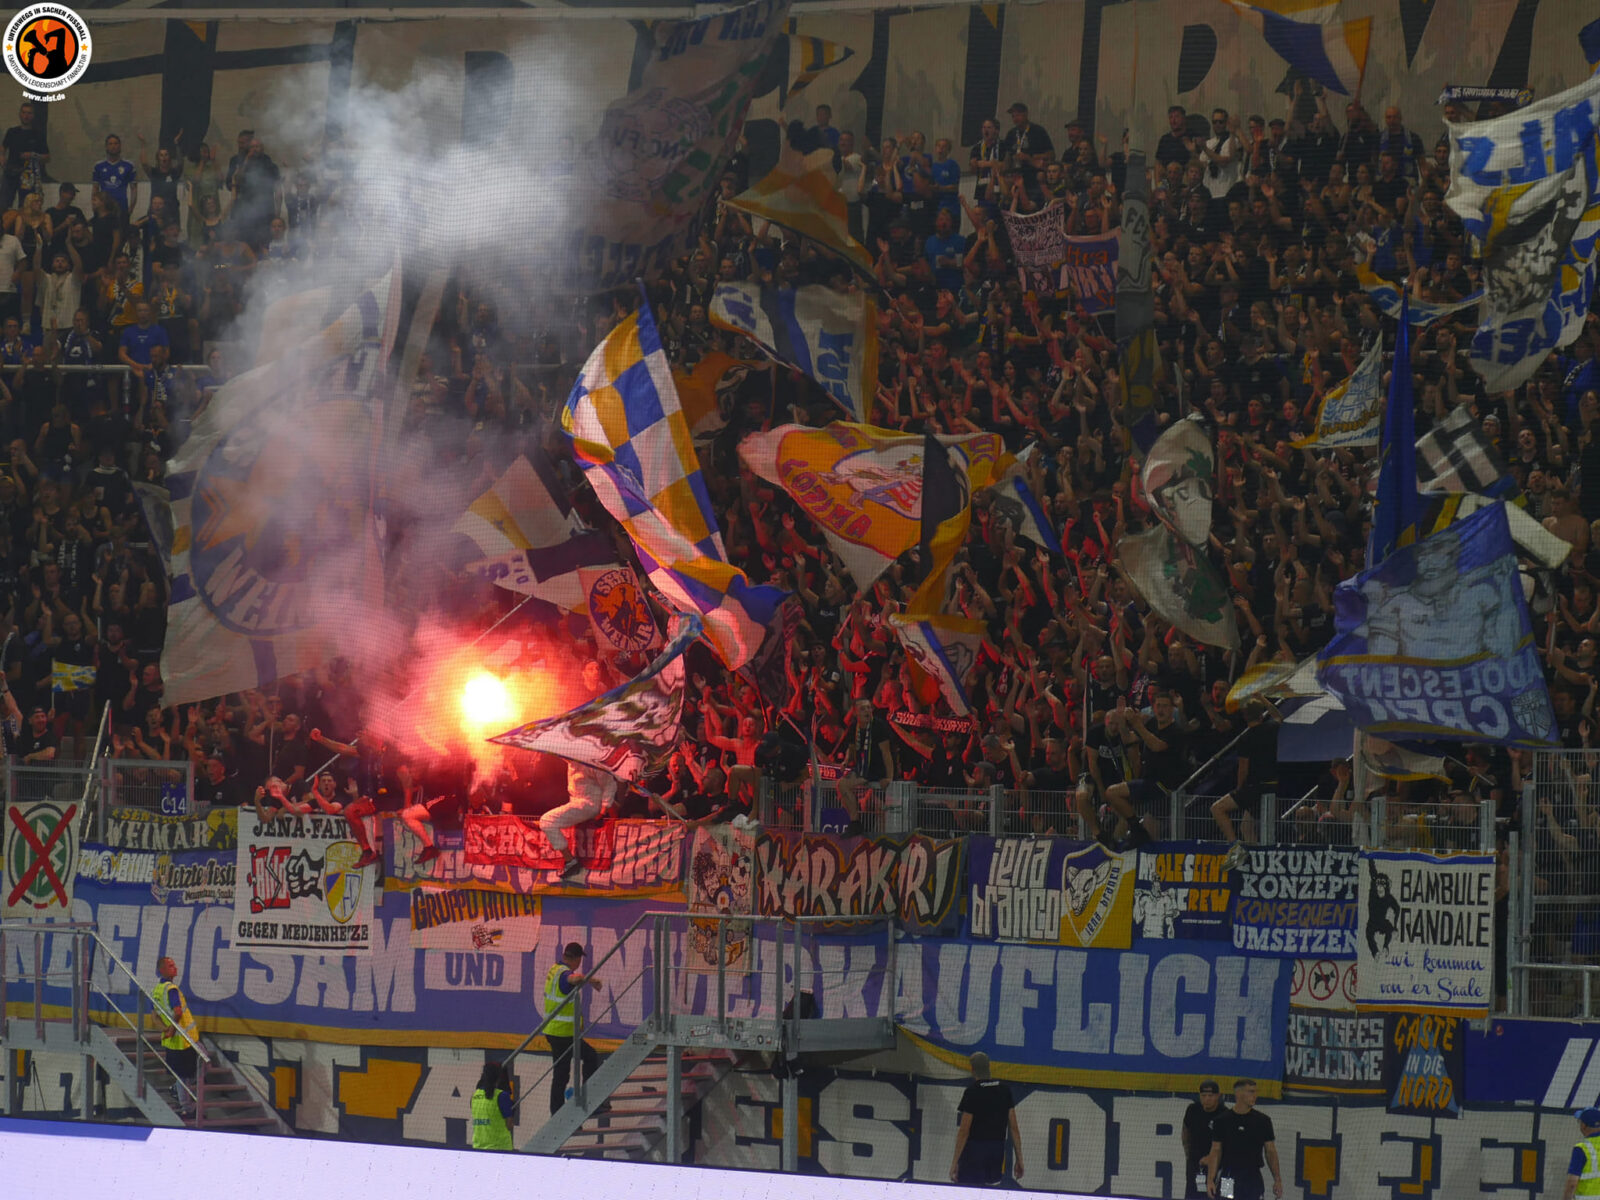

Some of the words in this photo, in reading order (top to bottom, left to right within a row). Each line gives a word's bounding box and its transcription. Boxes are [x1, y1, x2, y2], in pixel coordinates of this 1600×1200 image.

[161, 797, 187, 814] C14
[106, 817, 209, 850] WEIMAR
[757, 839, 954, 917] HARAKIRI
[1239, 873, 1359, 900] KONZEPT
[1400, 869, 1491, 906] BAMBULE
[238, 920, 279, 939] GEGEN
[1233, 899, 1358, 929] KONSEQUENT
[1400, 908, 1490, 947] RANDALE
[445, 952, 505, 987] UND
[1437, 977, 1485, 1001] Saale
[1287, 1013, 1385, 1048] REFUGEES
[1285, 1046, 1384, 1081] WELCOME
[1404, 1053, 1419, 1073] IN
[1423, 1054, 1445, 1075] DIE
[1398, 1074, 1454, 1111] NORD
